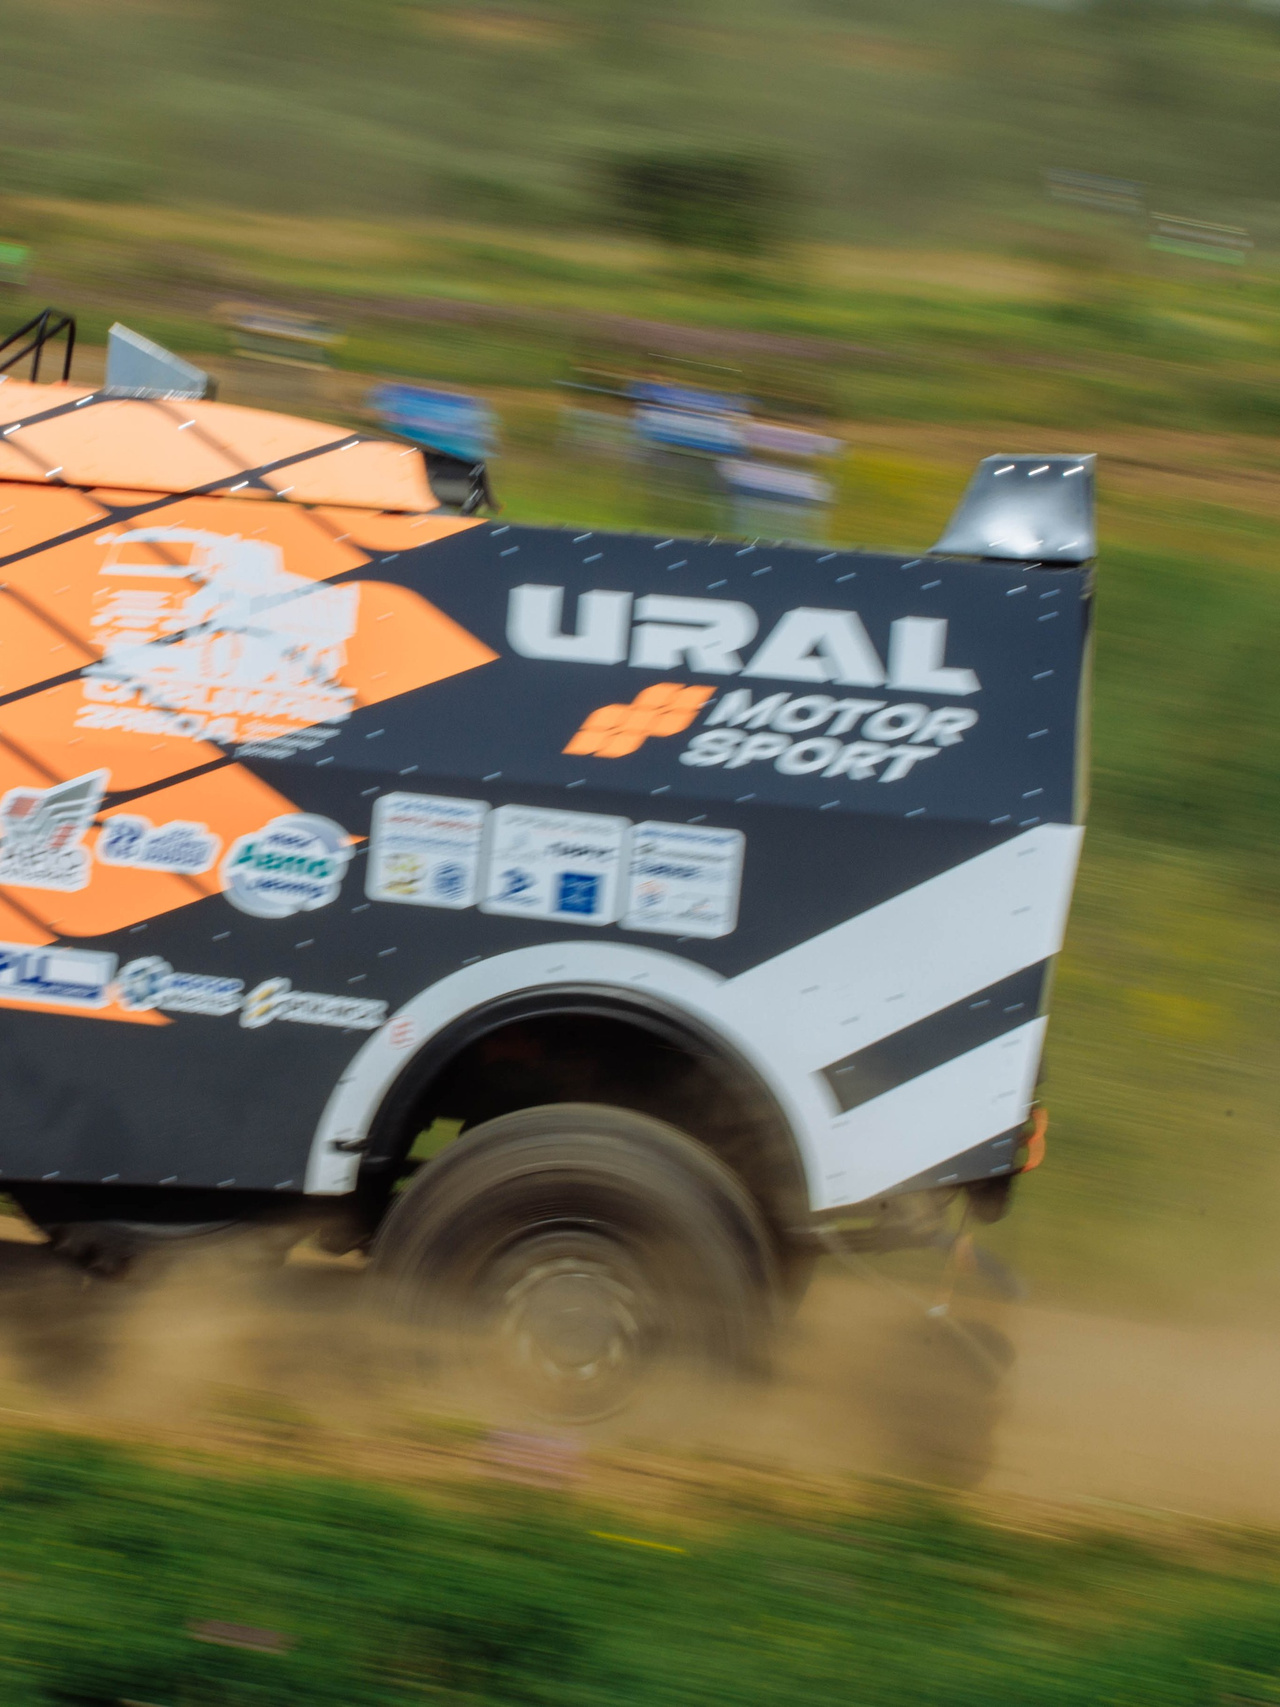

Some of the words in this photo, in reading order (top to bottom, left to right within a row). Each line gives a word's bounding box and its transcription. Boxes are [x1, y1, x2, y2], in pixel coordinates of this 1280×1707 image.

[506, 583, 982, 696] URAL
[703, 688, 980, 747] MOTOR
[678, 728, 941, 783] SPORT
